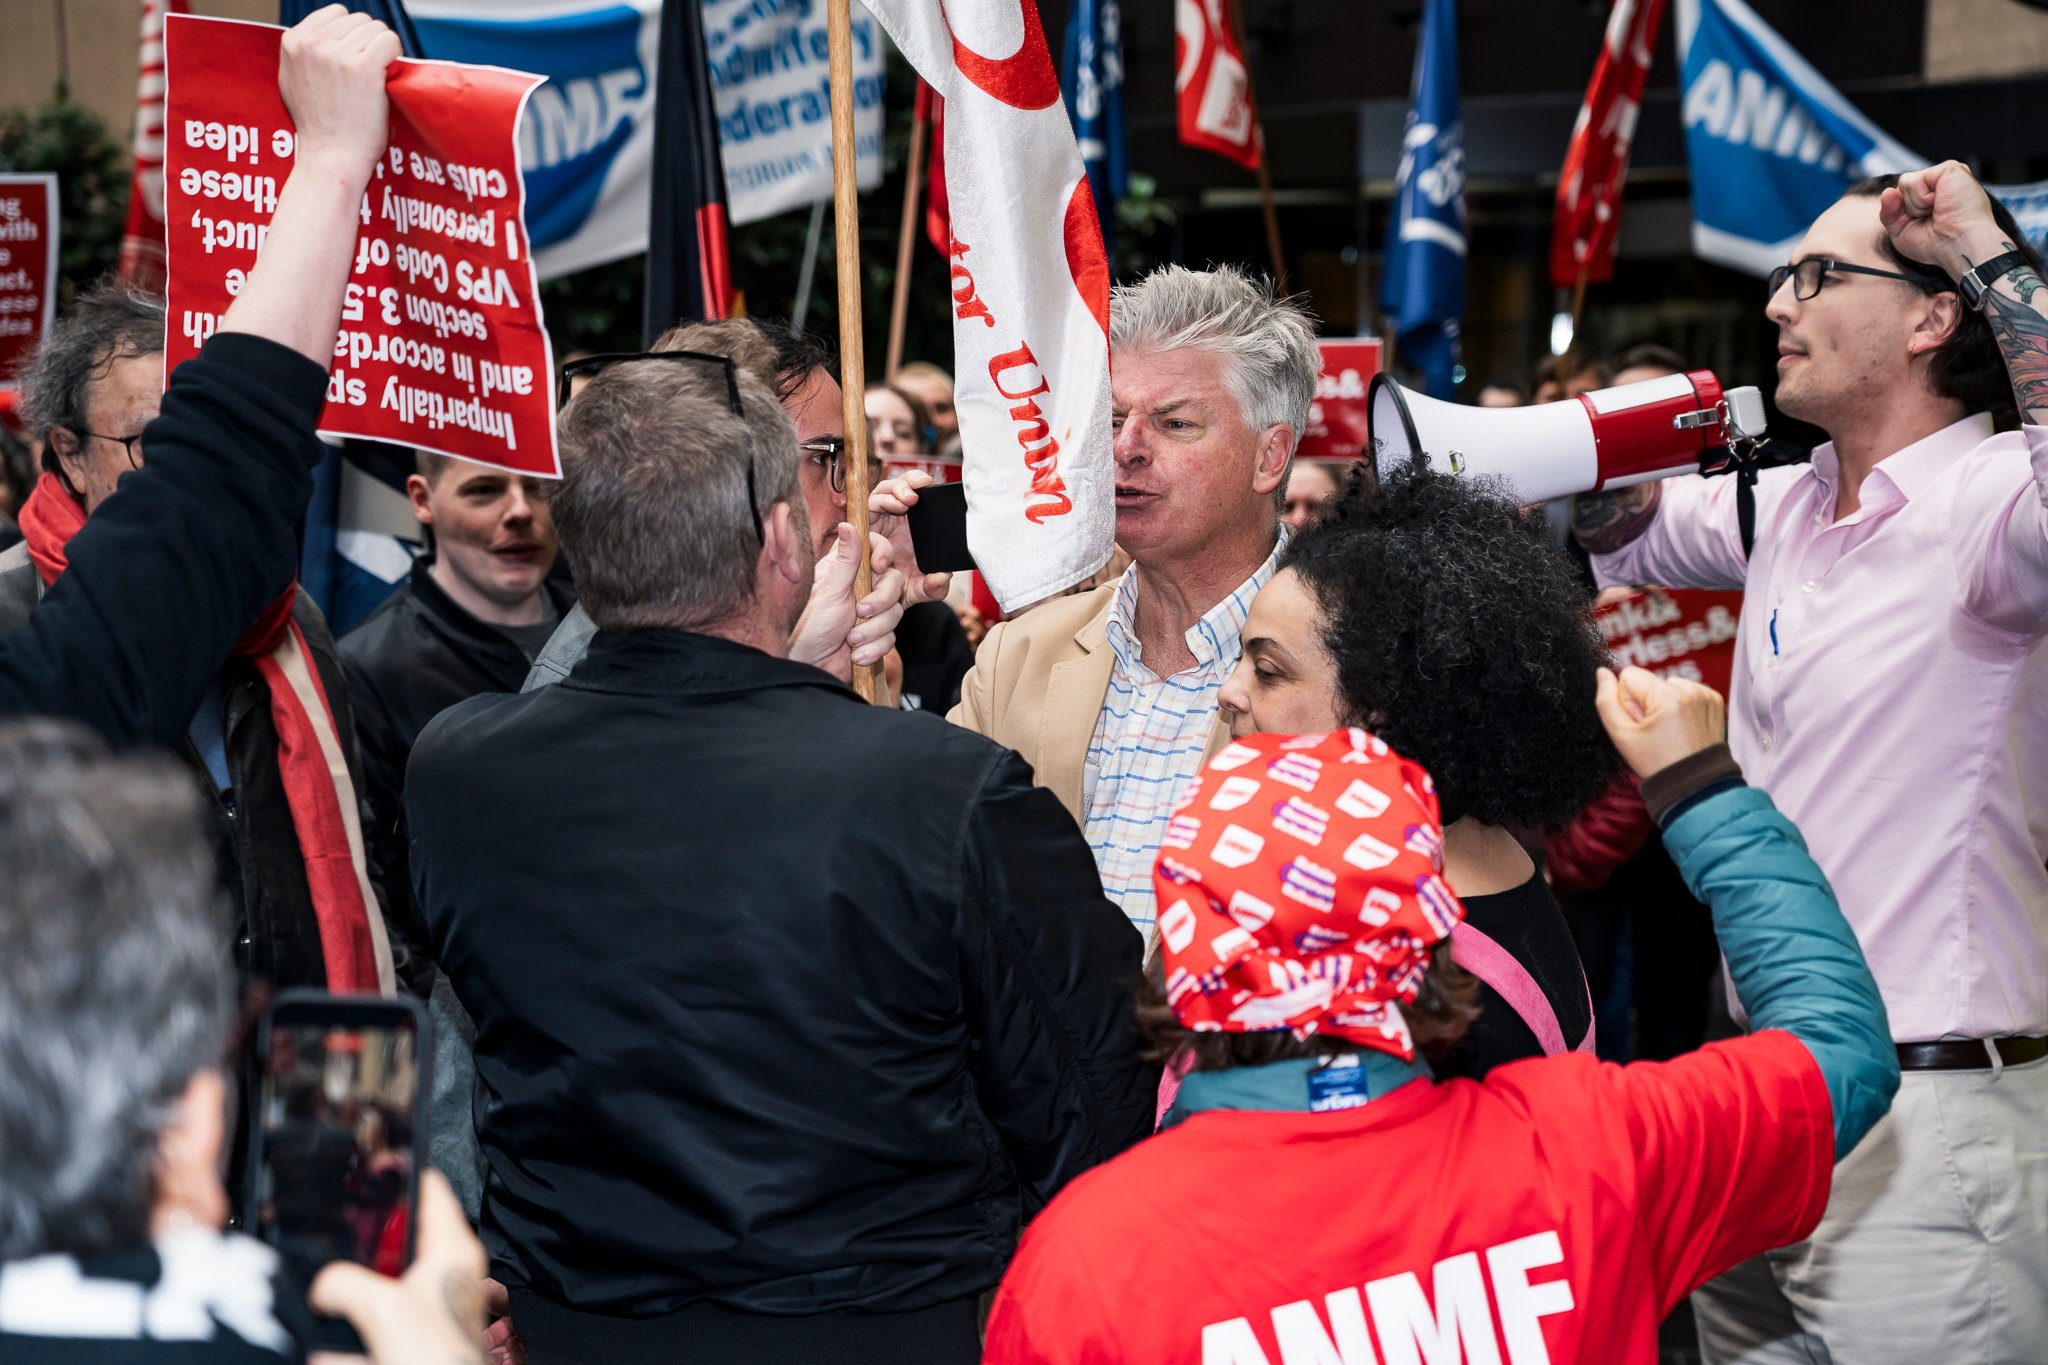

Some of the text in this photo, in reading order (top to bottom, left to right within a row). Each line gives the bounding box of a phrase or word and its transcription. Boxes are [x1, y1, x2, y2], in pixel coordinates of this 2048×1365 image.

[185, 120, 259, 165] idea
[389, 146, 404, 175] a
[180, 167, 277, 213] these
[409, 151, 446, 186] are
[446, 163, 508, 203] cuts
[381, 185, 495, 247] personally
[505, 220, 519, 260] I
[355, 237, 521, 308] VPS Code of
[342, 283, 488, 341] section 3.5
[334, 329, 534, 397] and in accorda
[326, 369, 516, 450] Impartially sp
